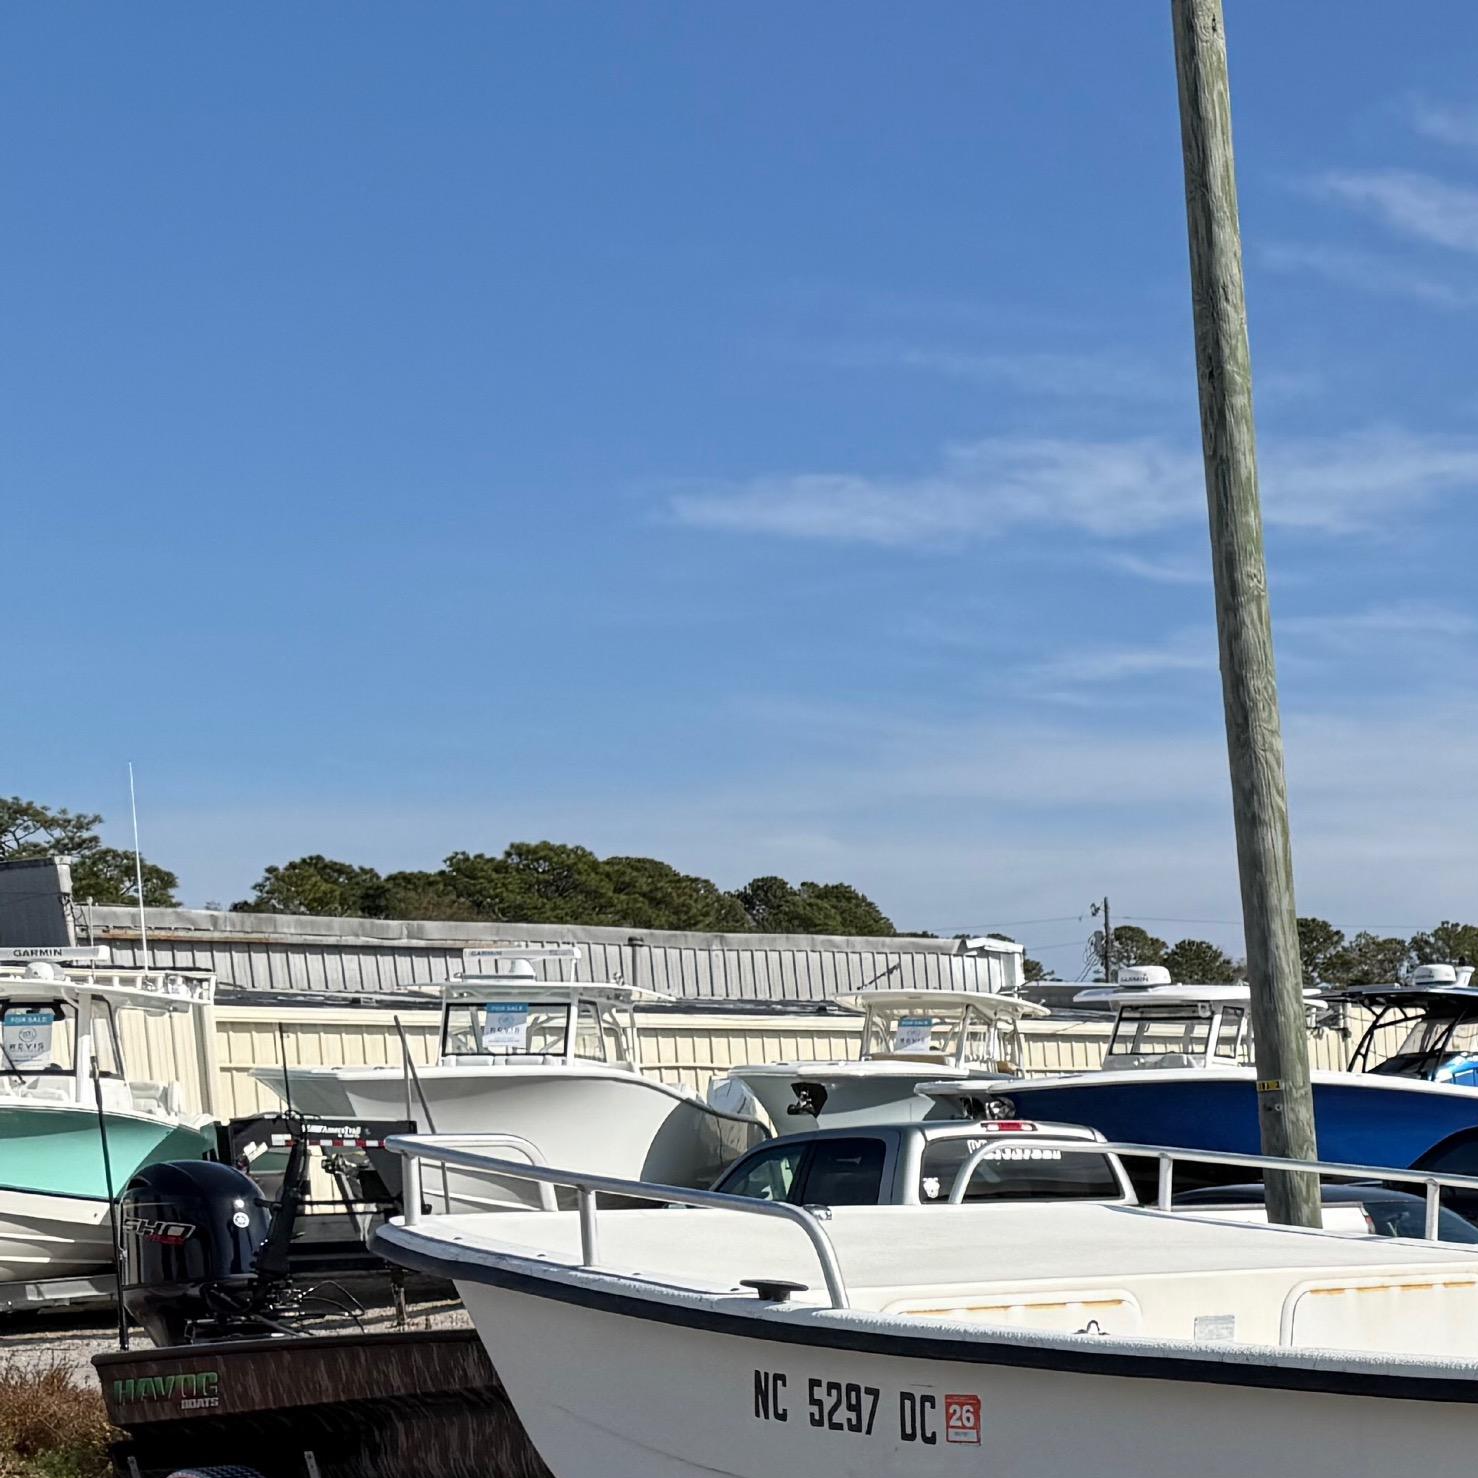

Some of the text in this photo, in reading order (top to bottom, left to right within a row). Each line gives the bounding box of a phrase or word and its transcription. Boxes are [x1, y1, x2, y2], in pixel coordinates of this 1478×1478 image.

[13, 949, 62, 957] GARMIN
[9, 1042, 44, 1051] REVIS
[113, 1371, 218, 1404] HAVOC
[754, 1369, 937, 1445] NC 5297 DC
[949, 1404, 975, 1427] 26
